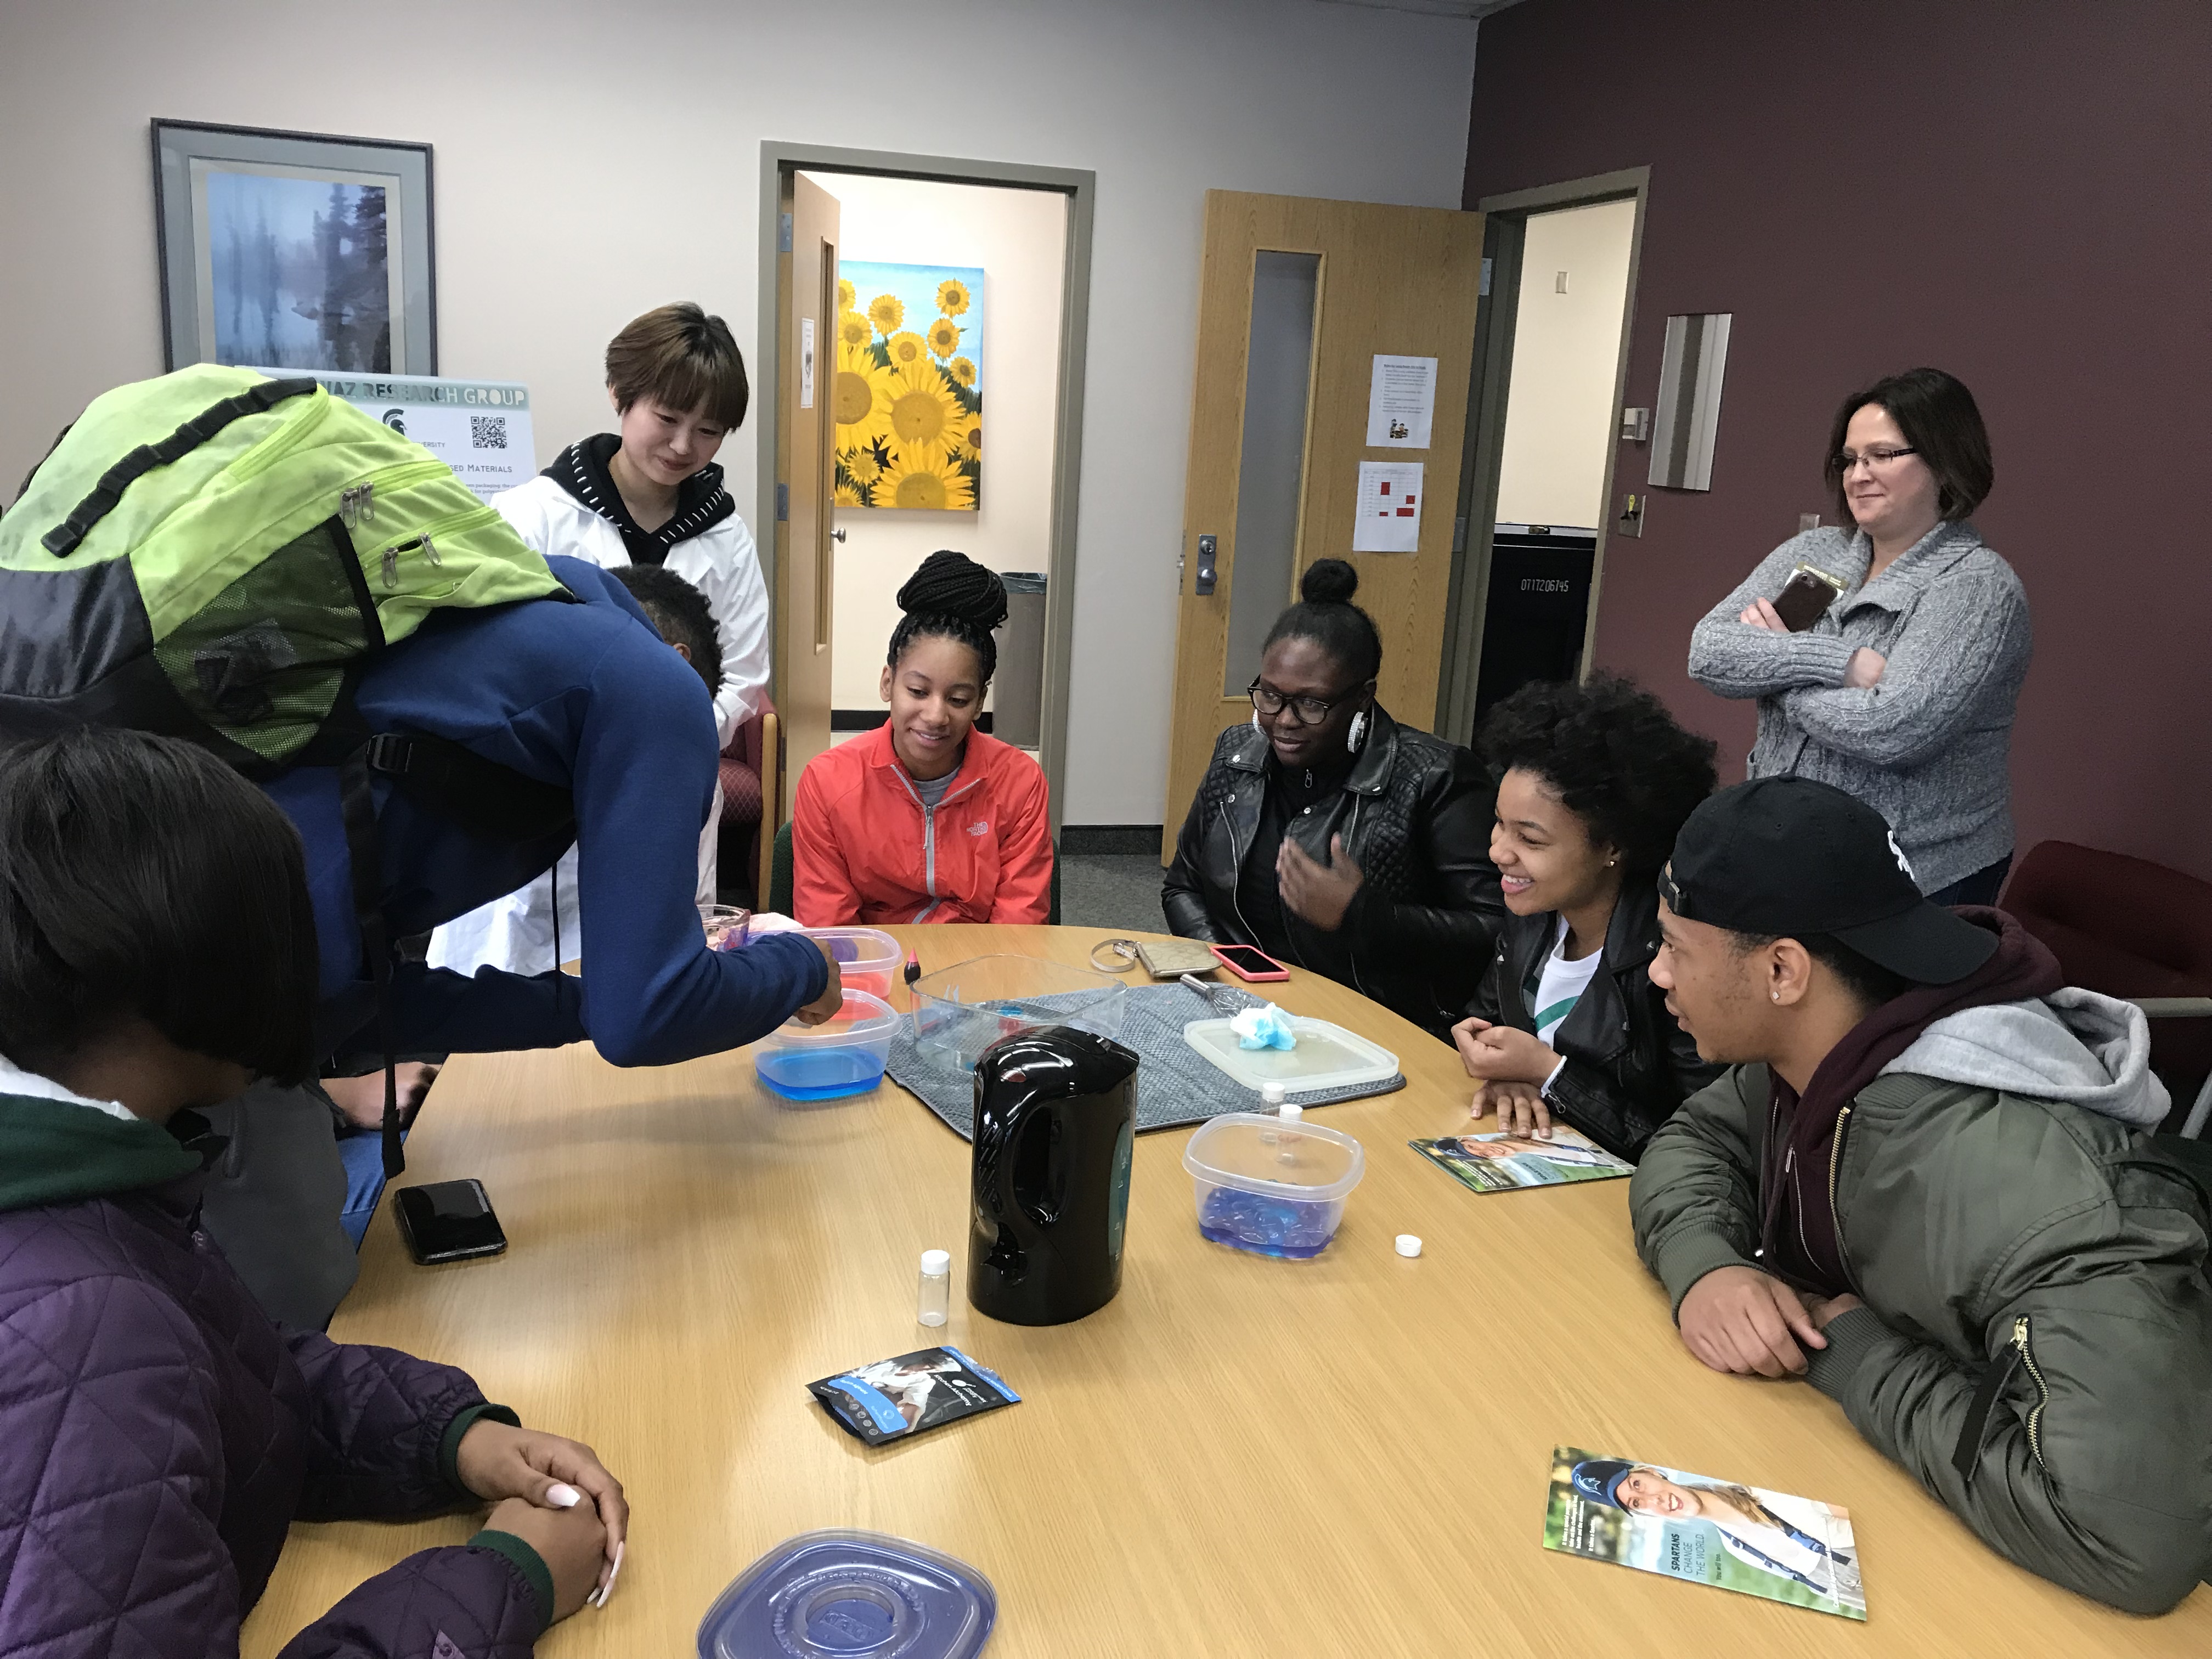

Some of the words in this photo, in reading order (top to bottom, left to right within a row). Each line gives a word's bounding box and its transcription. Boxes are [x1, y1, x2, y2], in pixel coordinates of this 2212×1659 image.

[362, 382, 458, 403] RESEARCH
[463, 387, 526, 406] GROUP
[933, 1374, 952, 1389] Kitchen
[951, 1388, 972, 1406] Alchemy
[1671, 1533, 1680, 1571] SPARTANS
[1683, 1542, 1692, 1573] CHANGE
[1695, 1533, 1705, 1559] WORLD.
[1696, 1561, 1705, 1576] THE
